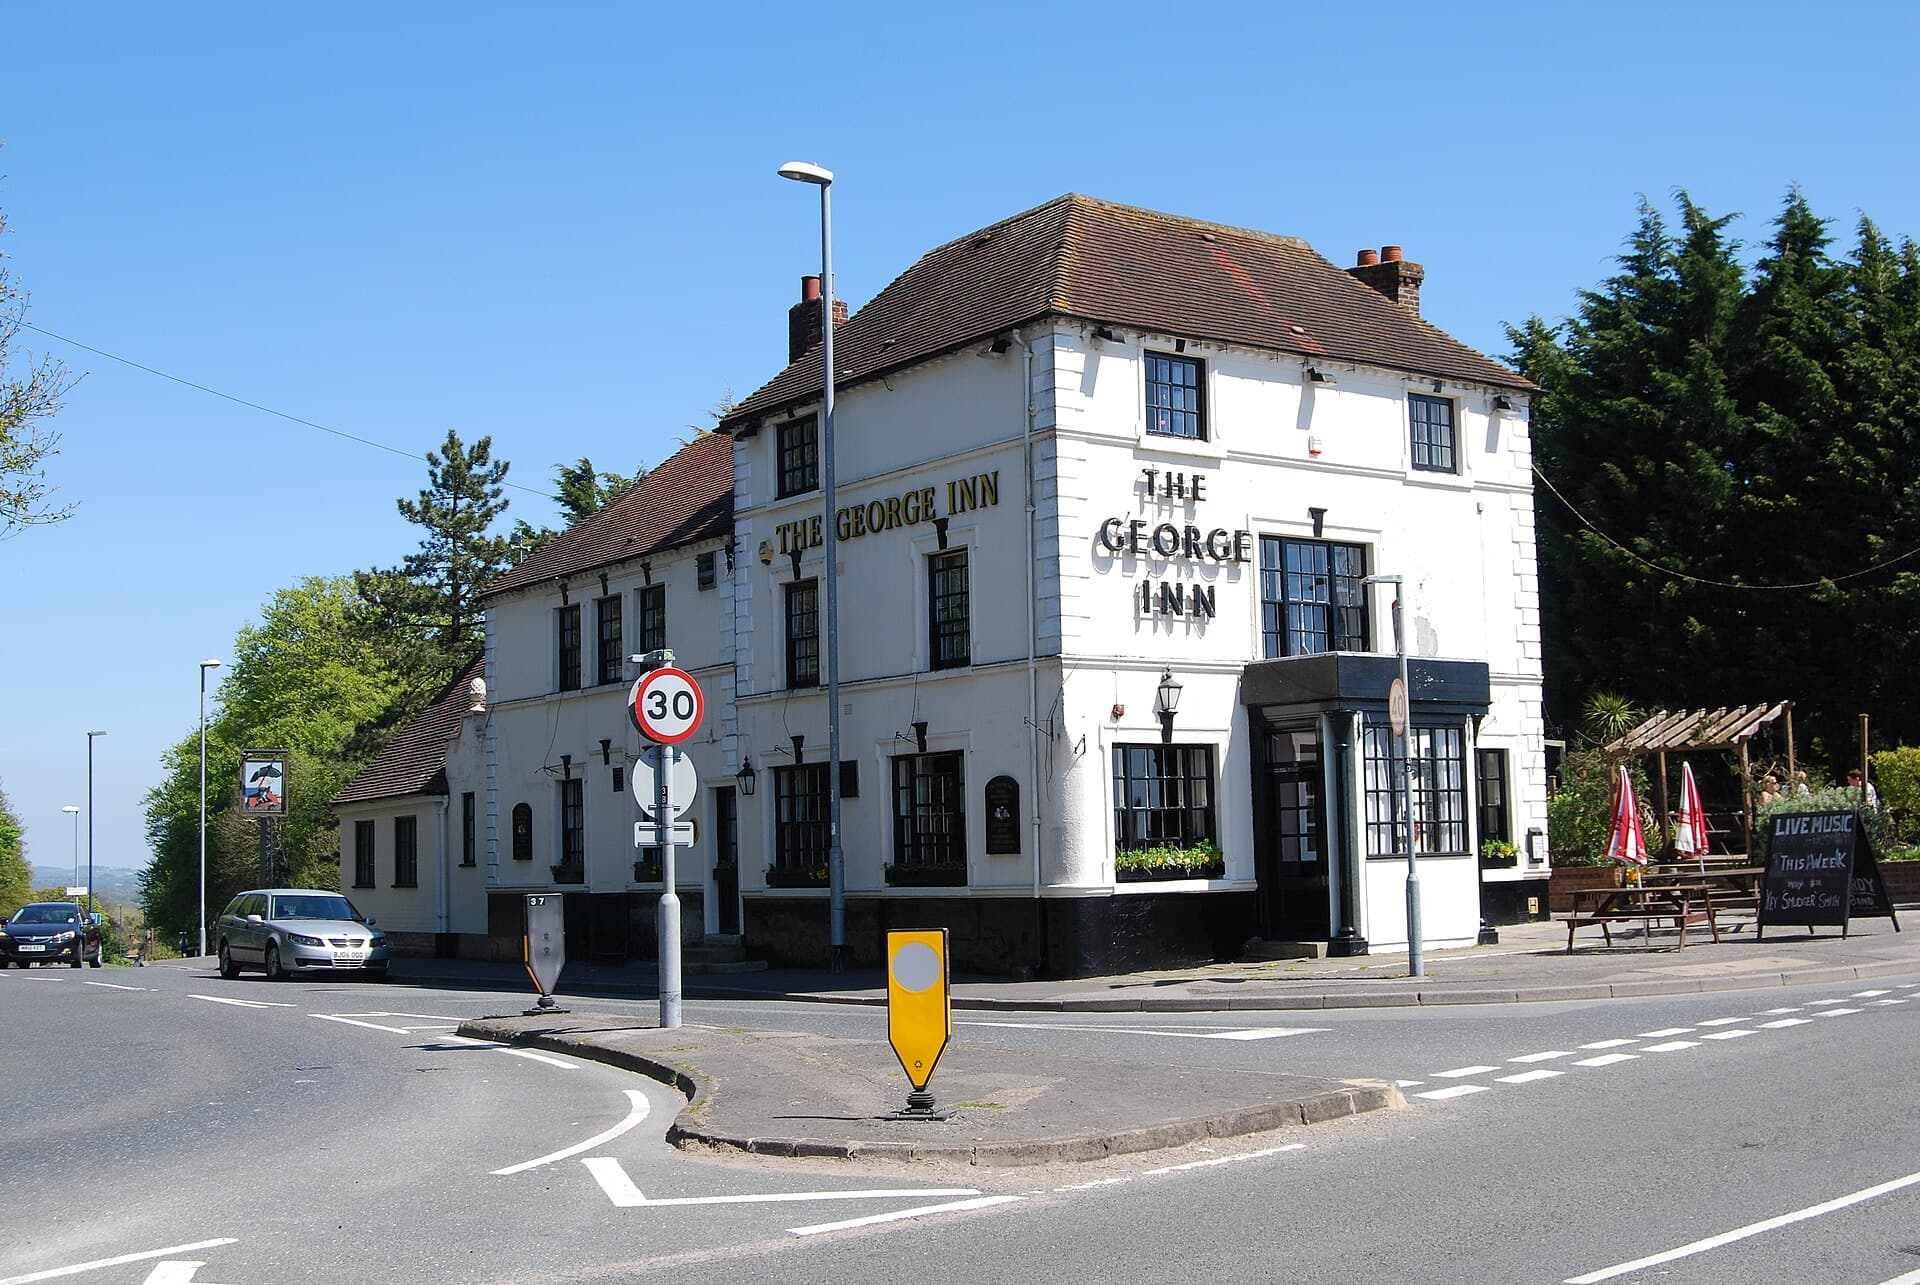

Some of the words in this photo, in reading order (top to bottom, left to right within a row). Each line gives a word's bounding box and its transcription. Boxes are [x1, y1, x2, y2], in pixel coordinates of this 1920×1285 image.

[1142, 469, 1206, 501] THE
[776, 515, 823, 554] THE
[834, 486, 937, 542] GEORGE
[947, 471, 999, 516] INN
[1100, 517, 1251, 562] GEORGE
[1143, 580, 1216, 618] INN
[647, 690, 694, 720] 30
[1392, 695, 1404, 718] 40
[1775, 817, 1810, 836] LIVE
[1811, 815, 1853, 833] MUSIC
[530, 897, 545, 906] 37
